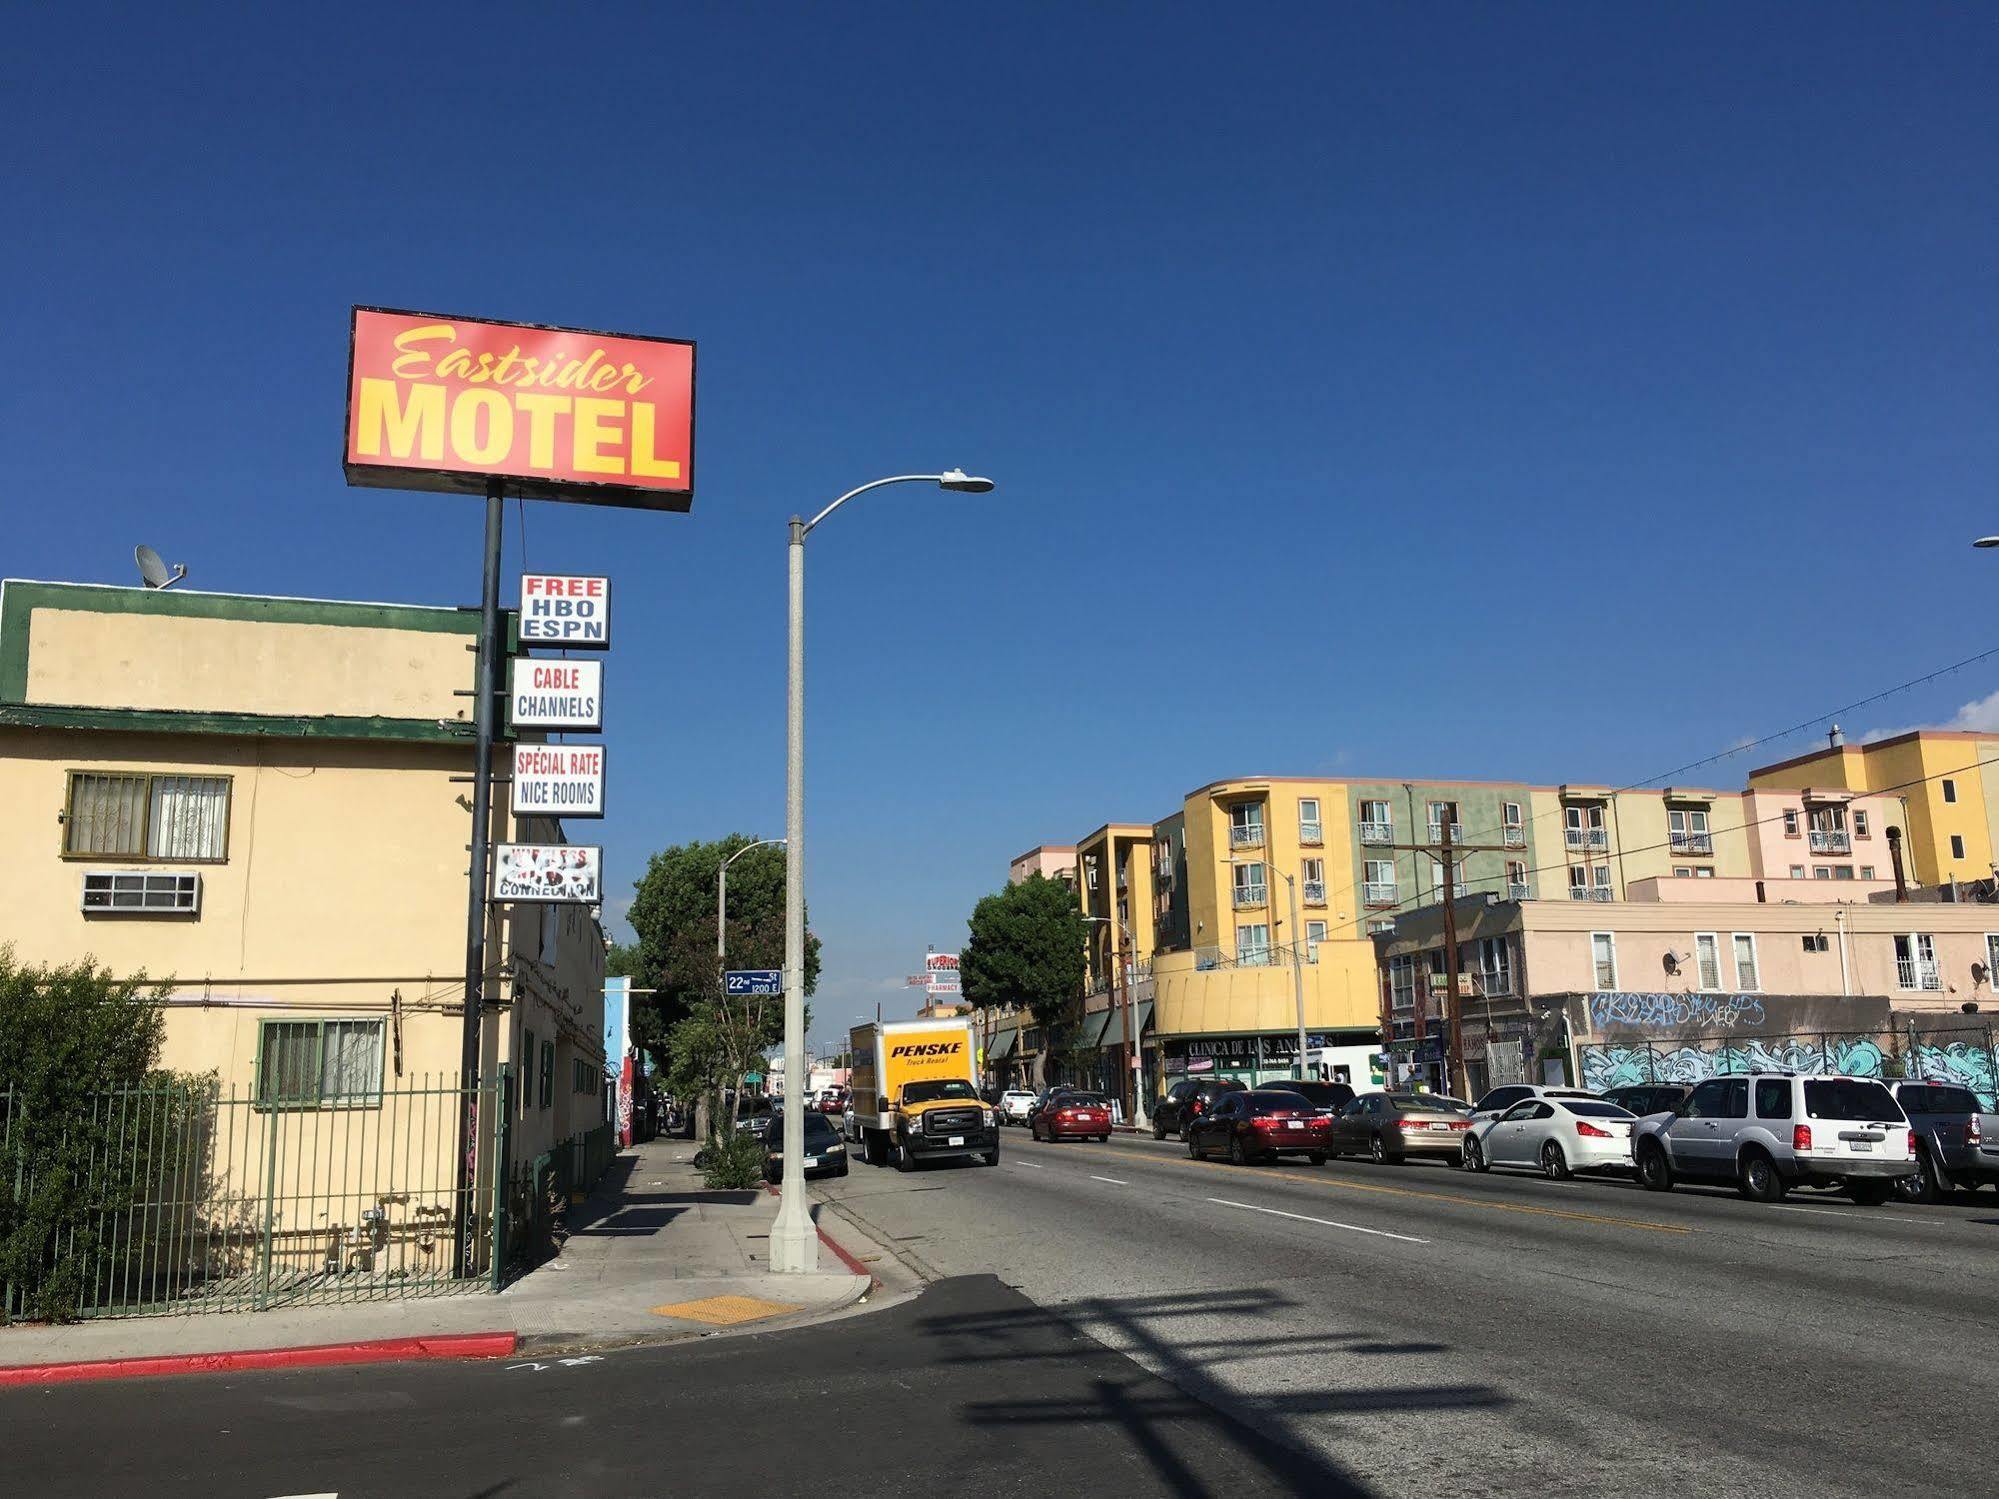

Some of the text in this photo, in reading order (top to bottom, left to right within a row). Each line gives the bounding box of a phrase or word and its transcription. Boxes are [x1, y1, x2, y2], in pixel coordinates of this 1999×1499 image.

[392, 325, 655, 395] Eastsider
[357, 377, 680, 479] MOTEL
[527, 578, 602, 597] FREE
[532, 599, 594, 617] HBO
[524, 620, 602, 638] ESPN
[534, 667, 579, 689] CABLE
[518, 695, 594, 718] CHANNELS
[518, 752, 599, 775] SPECIAL RATE
[521, 781, 594, 805] NICE ROOMS
[752, 983, 778, 993] 1200 E
[891, 1042, 963, 1058] PENSKE
[1188, 1041, 1230, 1057] CLINICA
[1231, 1040, 1244, 1055] DE
[906, 1057, 949, 1067] Truck Rental
